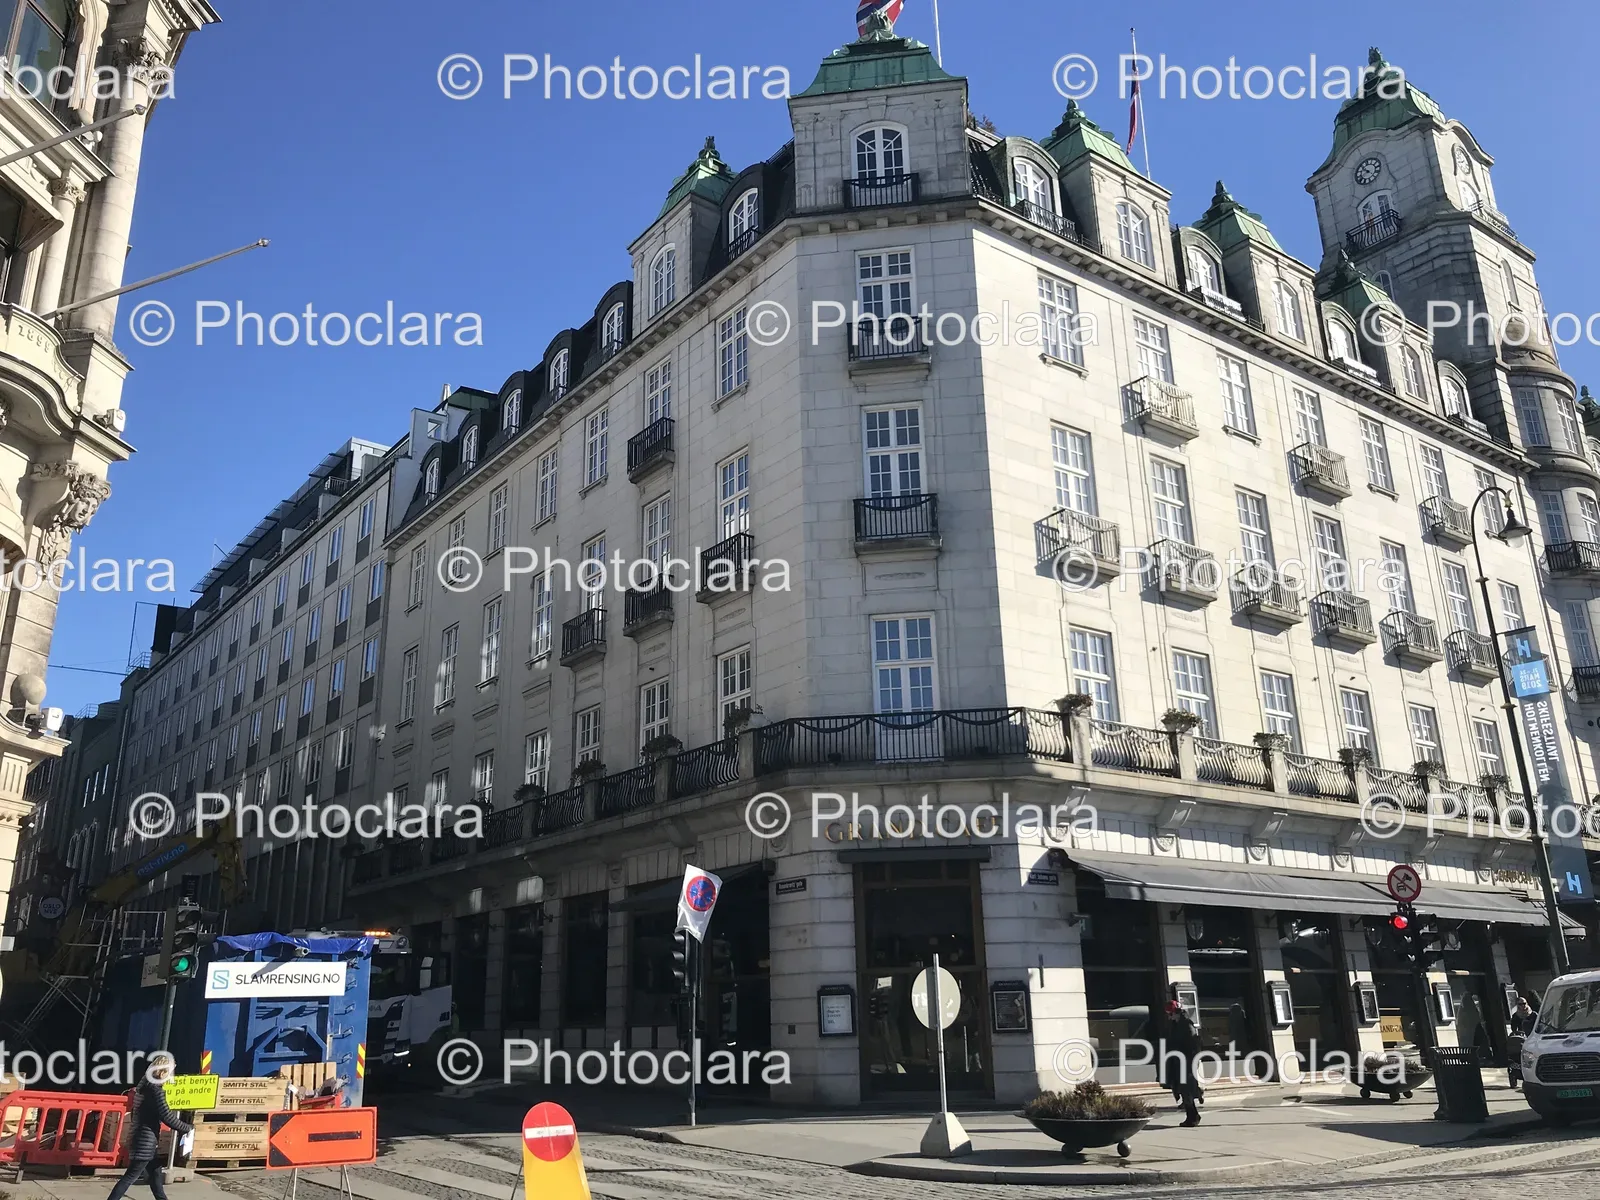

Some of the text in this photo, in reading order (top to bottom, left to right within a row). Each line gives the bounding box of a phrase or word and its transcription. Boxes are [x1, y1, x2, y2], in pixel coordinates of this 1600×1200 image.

[235, 973, 340, 985] SLAMRENSING.NO
[190, 1076, 216, 1086] benytt
[188, 1087, 212, 1095] andre
